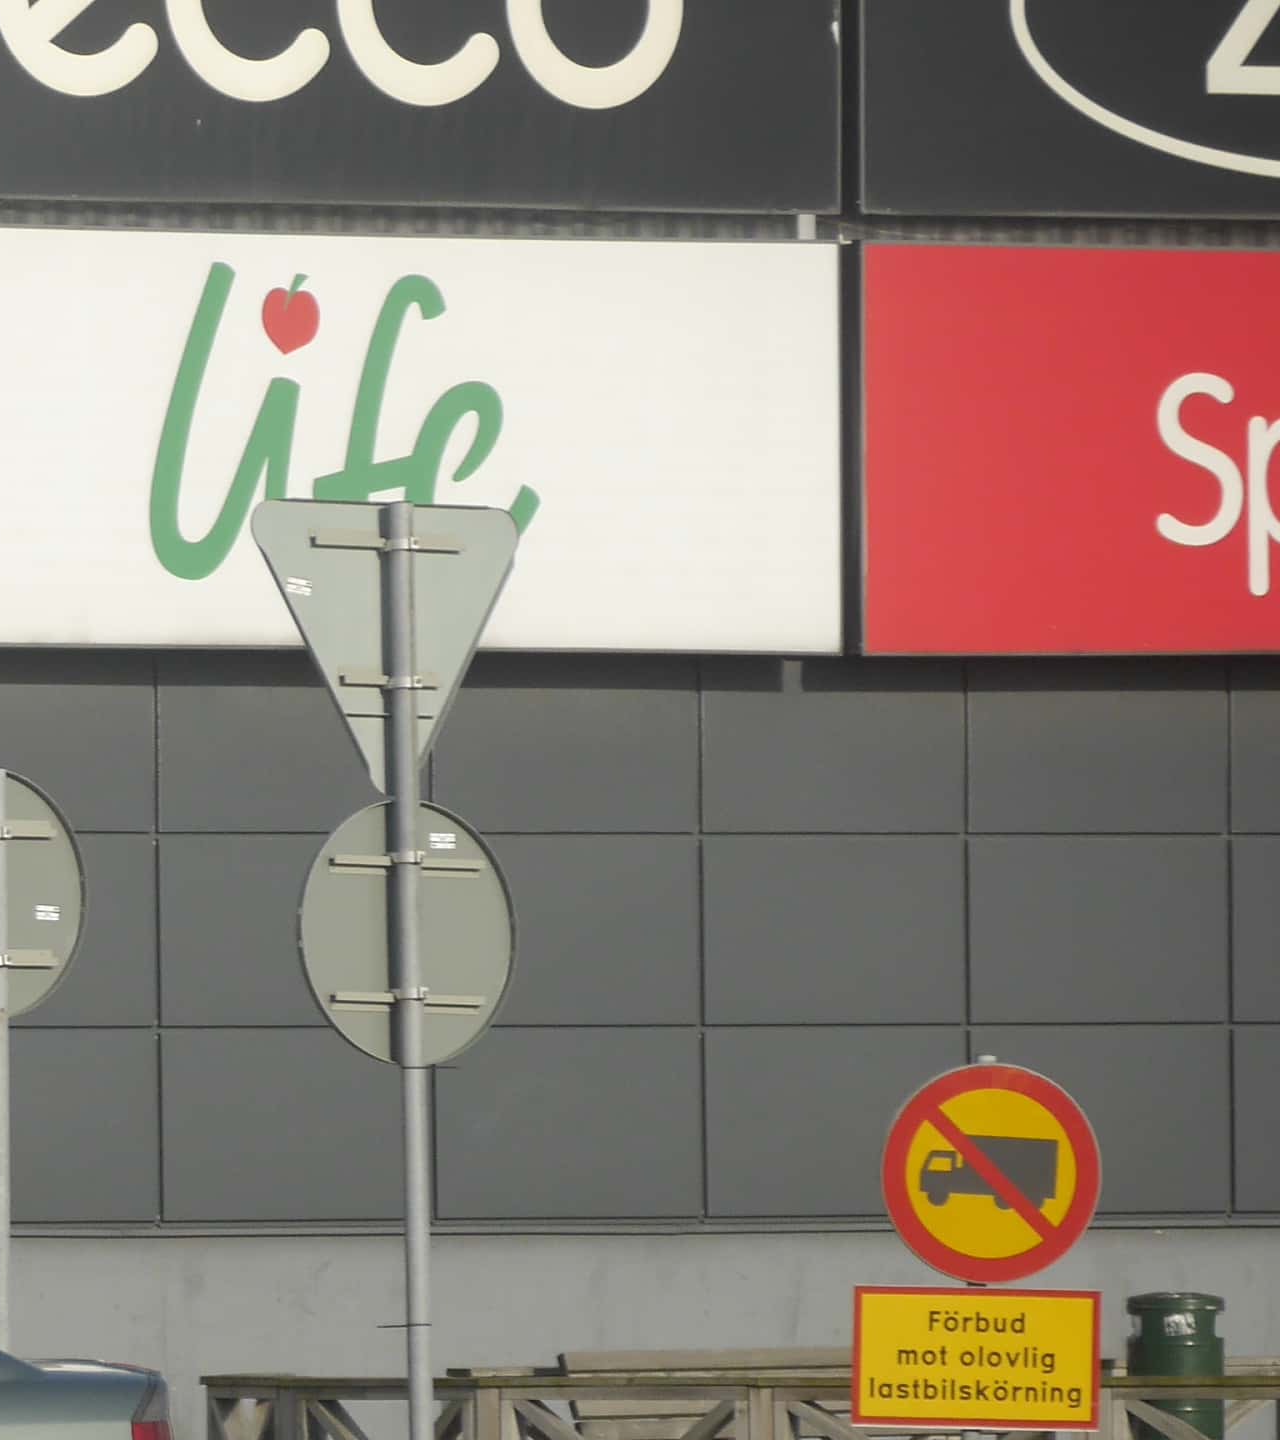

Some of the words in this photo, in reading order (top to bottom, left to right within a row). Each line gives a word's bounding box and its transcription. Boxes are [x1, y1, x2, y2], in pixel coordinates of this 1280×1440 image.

[928, 1310, 1026, 1334] Förbud
[897, 1345, 948, 1366] mot
[960, 1346, 1056, 1374] olovlig
[869, 1377, 1083, 1409] lastbilskörning
